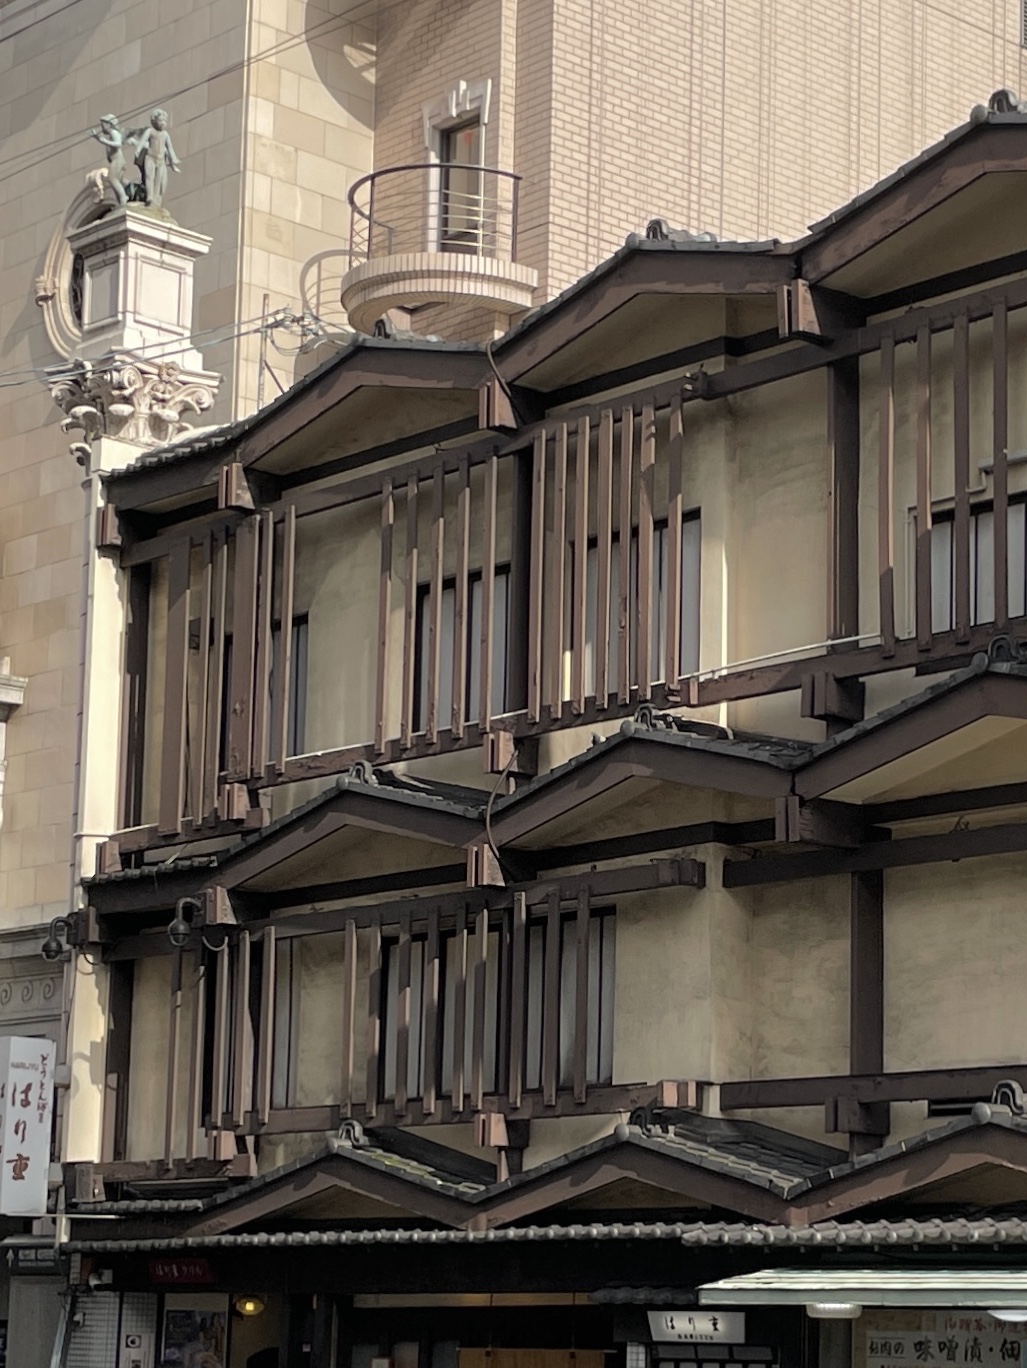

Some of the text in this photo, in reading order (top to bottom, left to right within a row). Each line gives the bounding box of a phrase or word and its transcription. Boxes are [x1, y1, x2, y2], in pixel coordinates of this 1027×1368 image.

[6, 1082, 33, 1181] はり重
[664, 1316, 719, 1331] はり重
